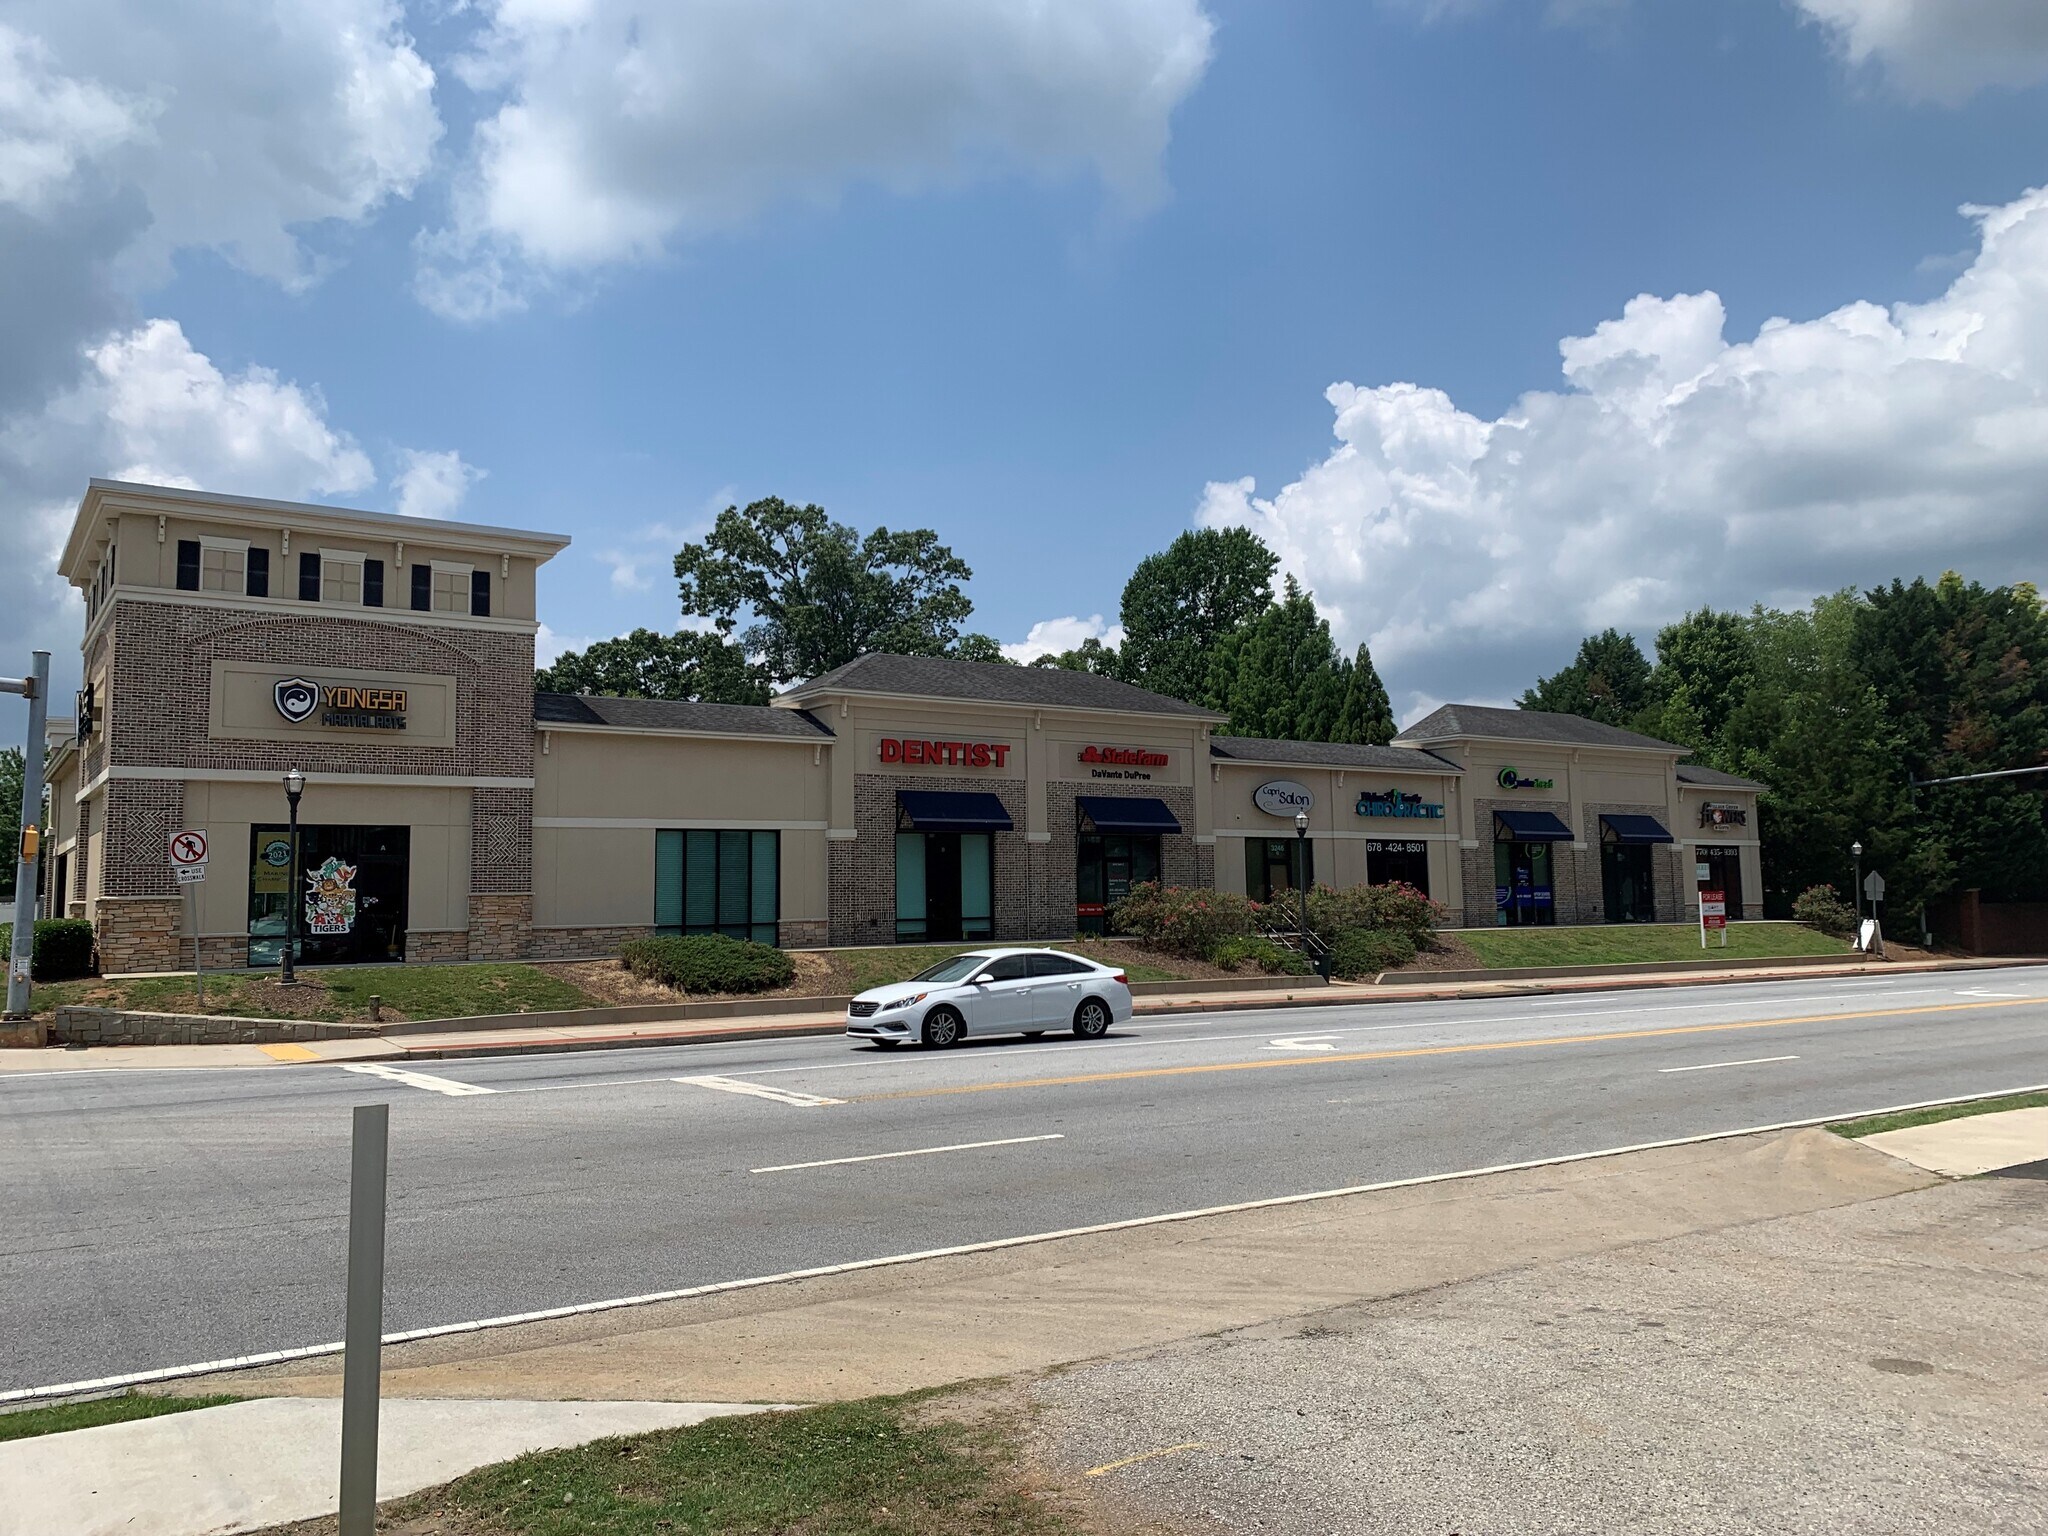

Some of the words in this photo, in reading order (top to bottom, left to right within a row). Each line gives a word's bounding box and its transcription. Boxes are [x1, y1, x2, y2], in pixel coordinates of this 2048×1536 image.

[323, 686, 407, 712] YONGSA
[375, 716, 407, 730] ARTS
[880, 738, 1011, 768] DENTIST
[1092, 769, 1122, 779] DaVante
[1124, 771, 1151, 780] DuPree
[1263, 786, 1280, 797] Capri
[1279, 791, 1310, 806] Salon
[1356, 799, 1445, 819] CHIROPRACTIC
[1367, 842, 1382, 852] 678
[1406, 843, 1425, 852] 8501
[268, 850, 288, 859] 2021
[178, 874, 205, 882] CROSSWALK
[1702, 893, 1711, 901] FOR
[1711, 893, 1723, 901] LEASE
[313, 924, 347, 932] TIGERS
